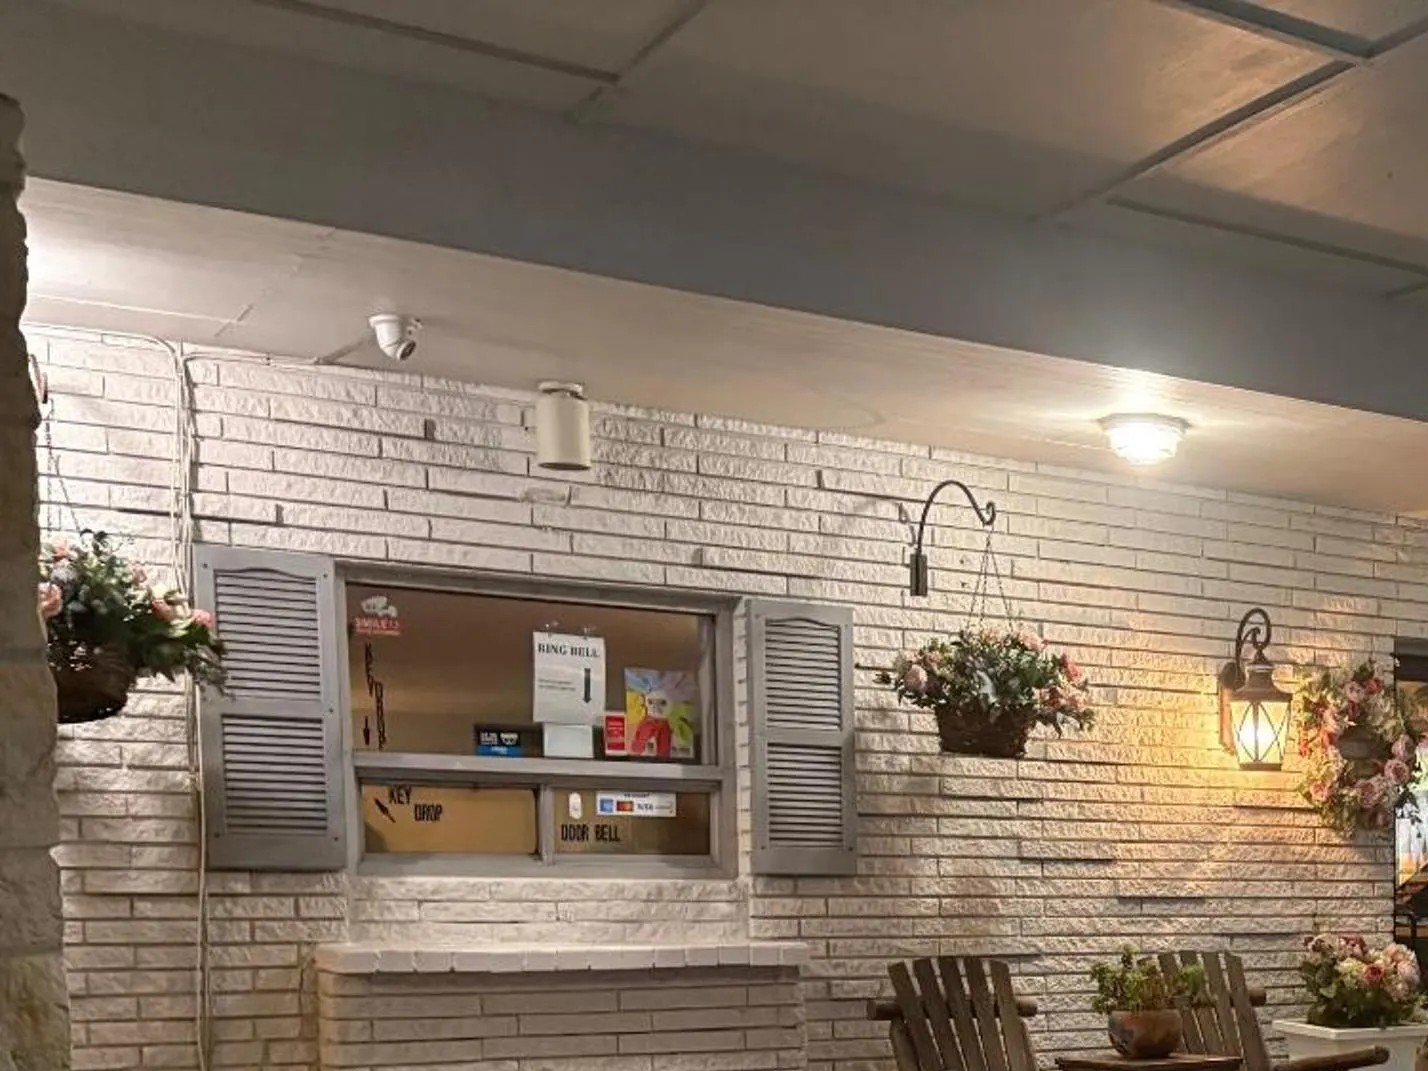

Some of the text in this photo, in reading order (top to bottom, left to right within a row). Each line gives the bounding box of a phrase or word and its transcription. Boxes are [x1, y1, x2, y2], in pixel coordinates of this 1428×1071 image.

[538, 643, 600, 658] RING BELL
[388, 784, 412, 805] KEY
[414, 803, 443, 822] DROP
[561, 823, 622, 842] DOOR BELL
